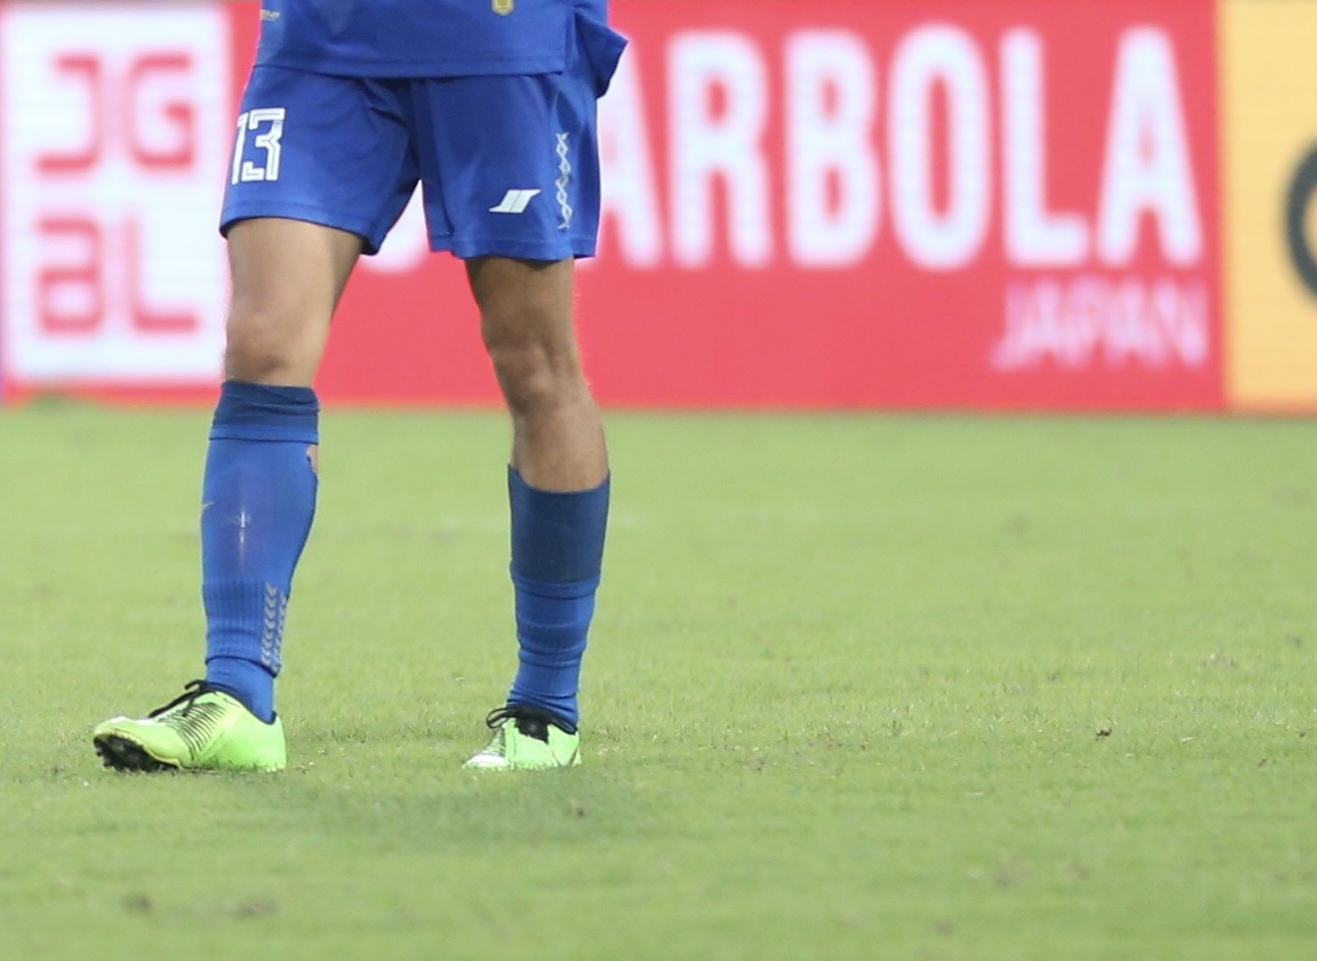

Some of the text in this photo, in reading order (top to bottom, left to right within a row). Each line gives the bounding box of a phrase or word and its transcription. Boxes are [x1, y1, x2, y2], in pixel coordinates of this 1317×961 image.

[230, 107, 286, 186] 13
[586, 23, 1206, 272] ARBOLA
[990, 277, 1210, 369] JAPAN
